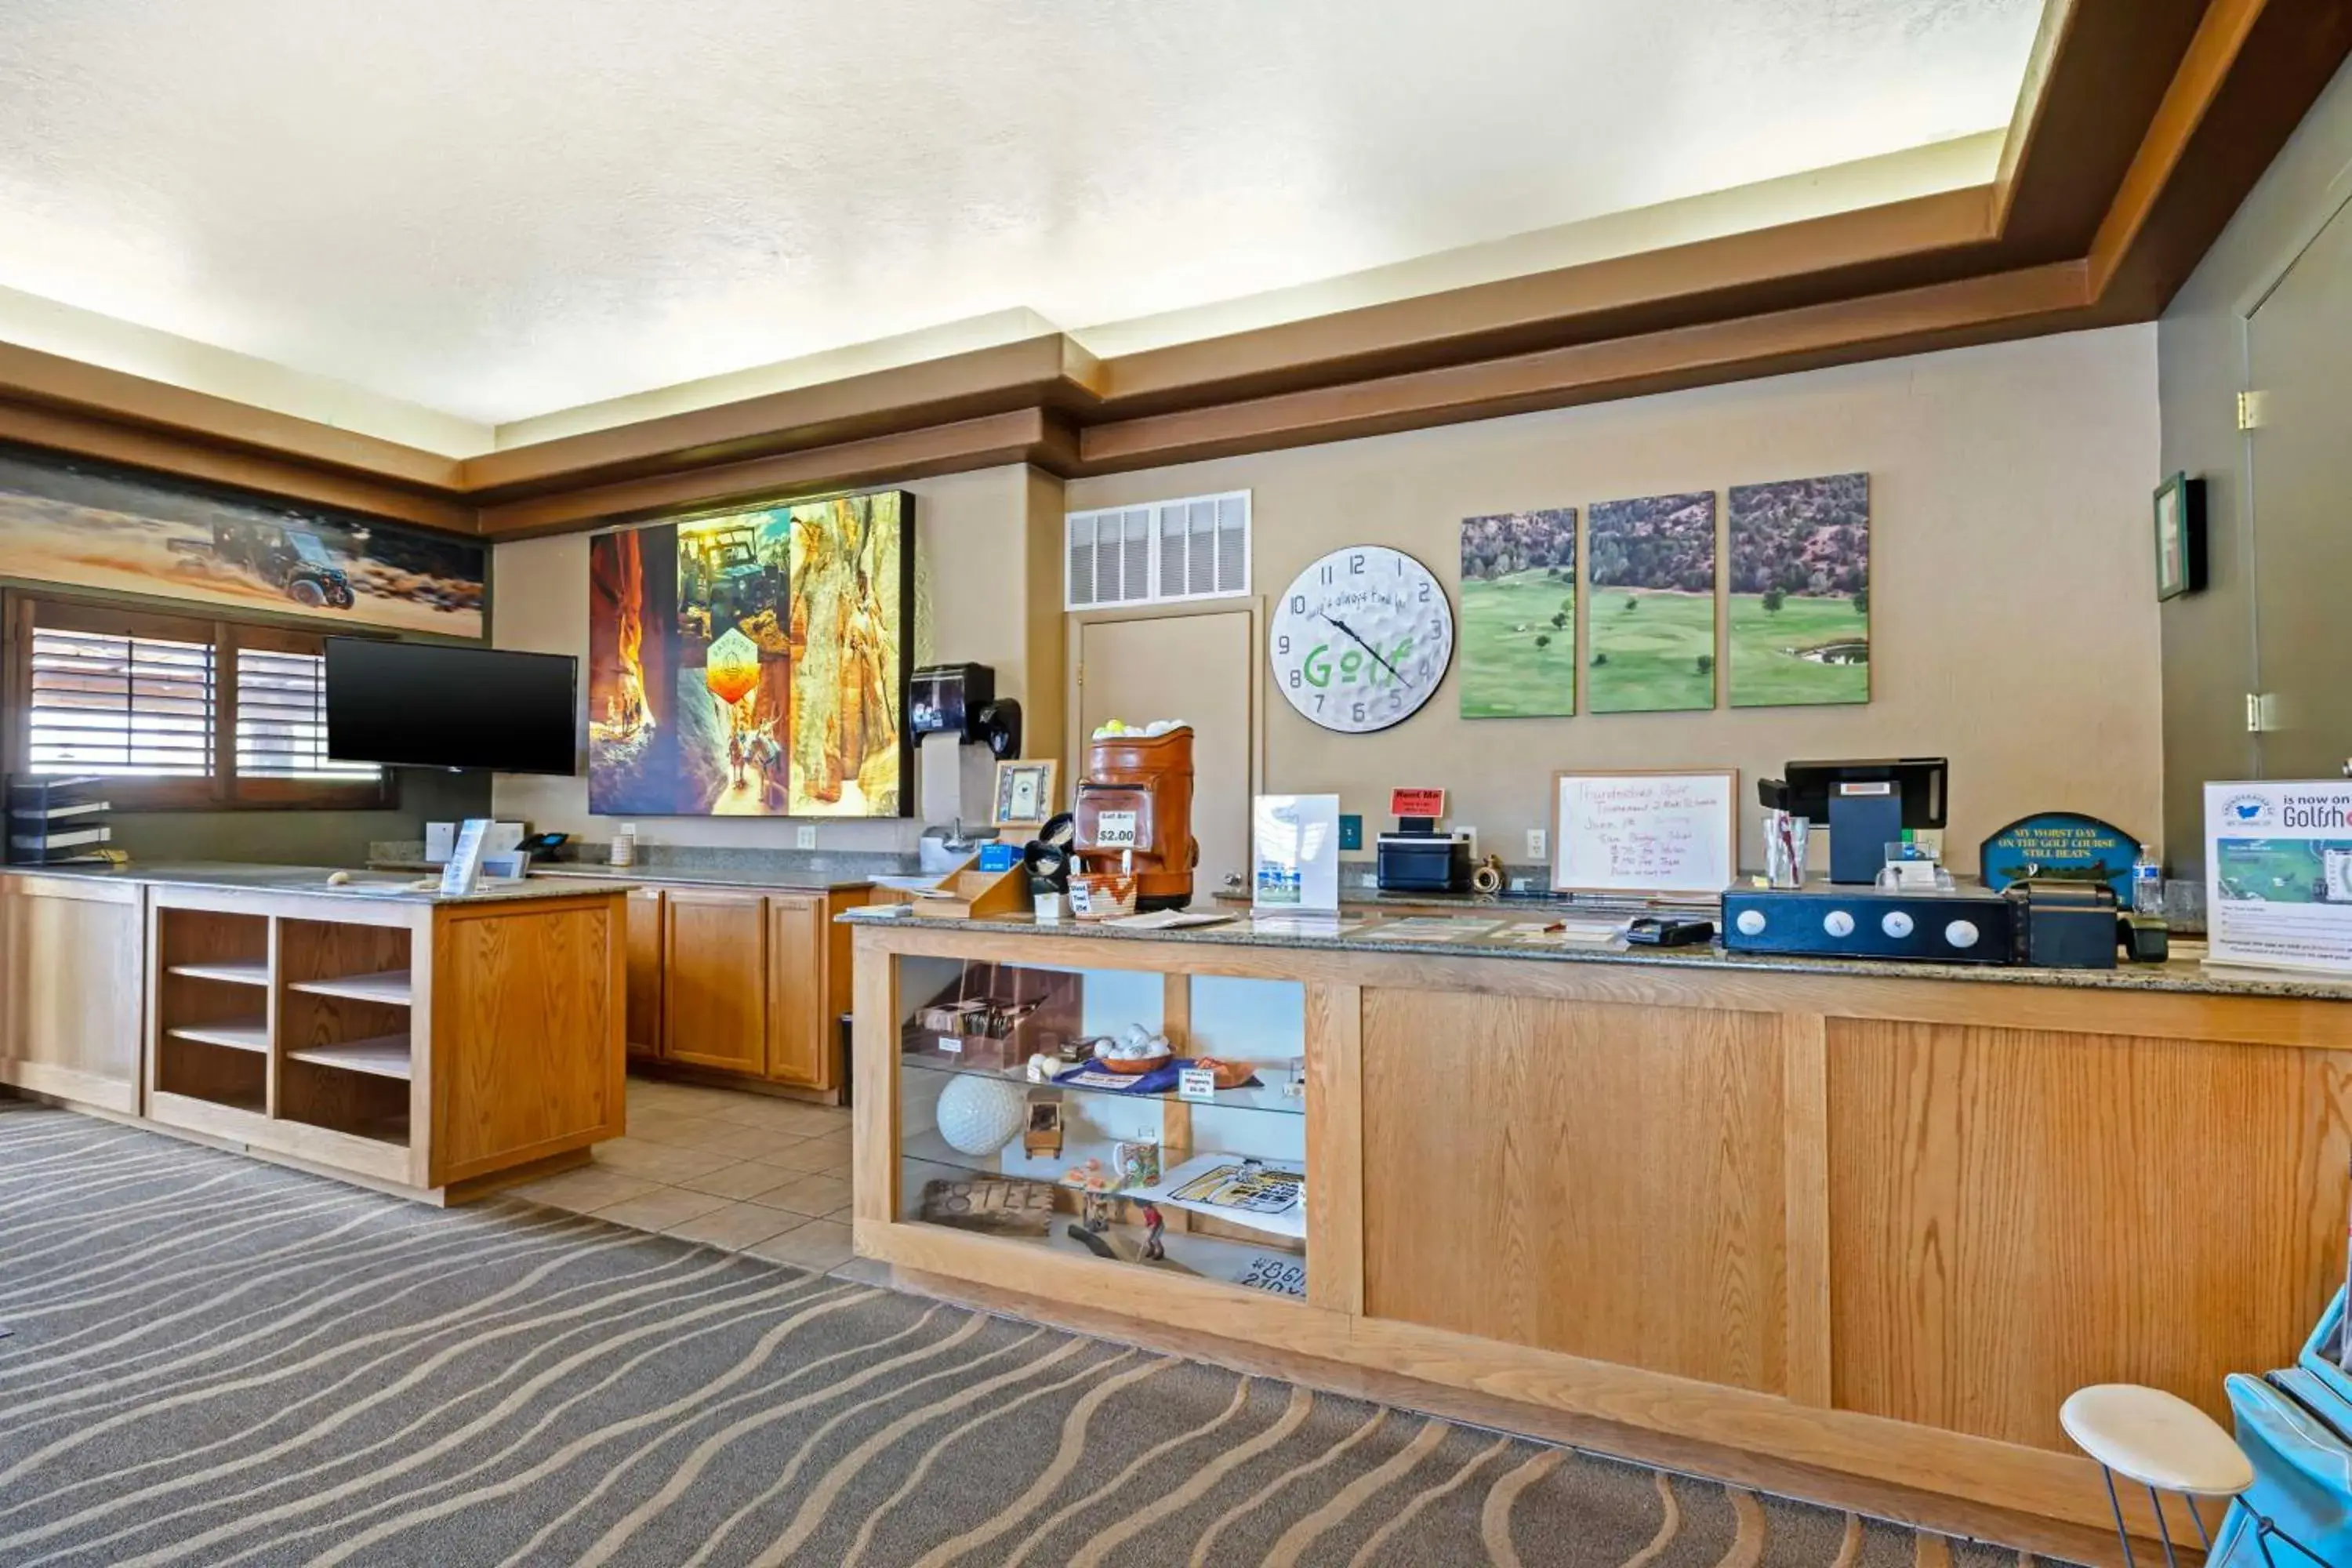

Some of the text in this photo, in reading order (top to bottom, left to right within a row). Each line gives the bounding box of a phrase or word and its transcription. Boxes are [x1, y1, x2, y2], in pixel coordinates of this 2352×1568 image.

[1349, 554, 1365, 575] 12
[1397, 557, 1402, 577] 1
[1320, 566, 1333, 585] 11
[1417, 583, 1431, 603] 2
[1290, 595, 1305, 615] 10
[1430, 619, 1442, 641] 3
[1279, 636, 1290, 655] 9
[1304, 637, 1414, 688] Golf
[1419, 659, 1431, 680] 4
[1290, 670, 1301, 688] 8
[1314, 694, 1325, 713] 7
[1390, 688, 1402, 709] 5
[1352, 702, 1365, 722] 6
[2284, 795, 2350, 805] is now on
[1099, 830, 1134, 841] $2.00
[2014, 828, 2098, 837] MY WORST DAY
[1998, 839, 2115, 848] ON THE GOLF COURSE
[2022, 849, 2092, 858] STILL BEATS
